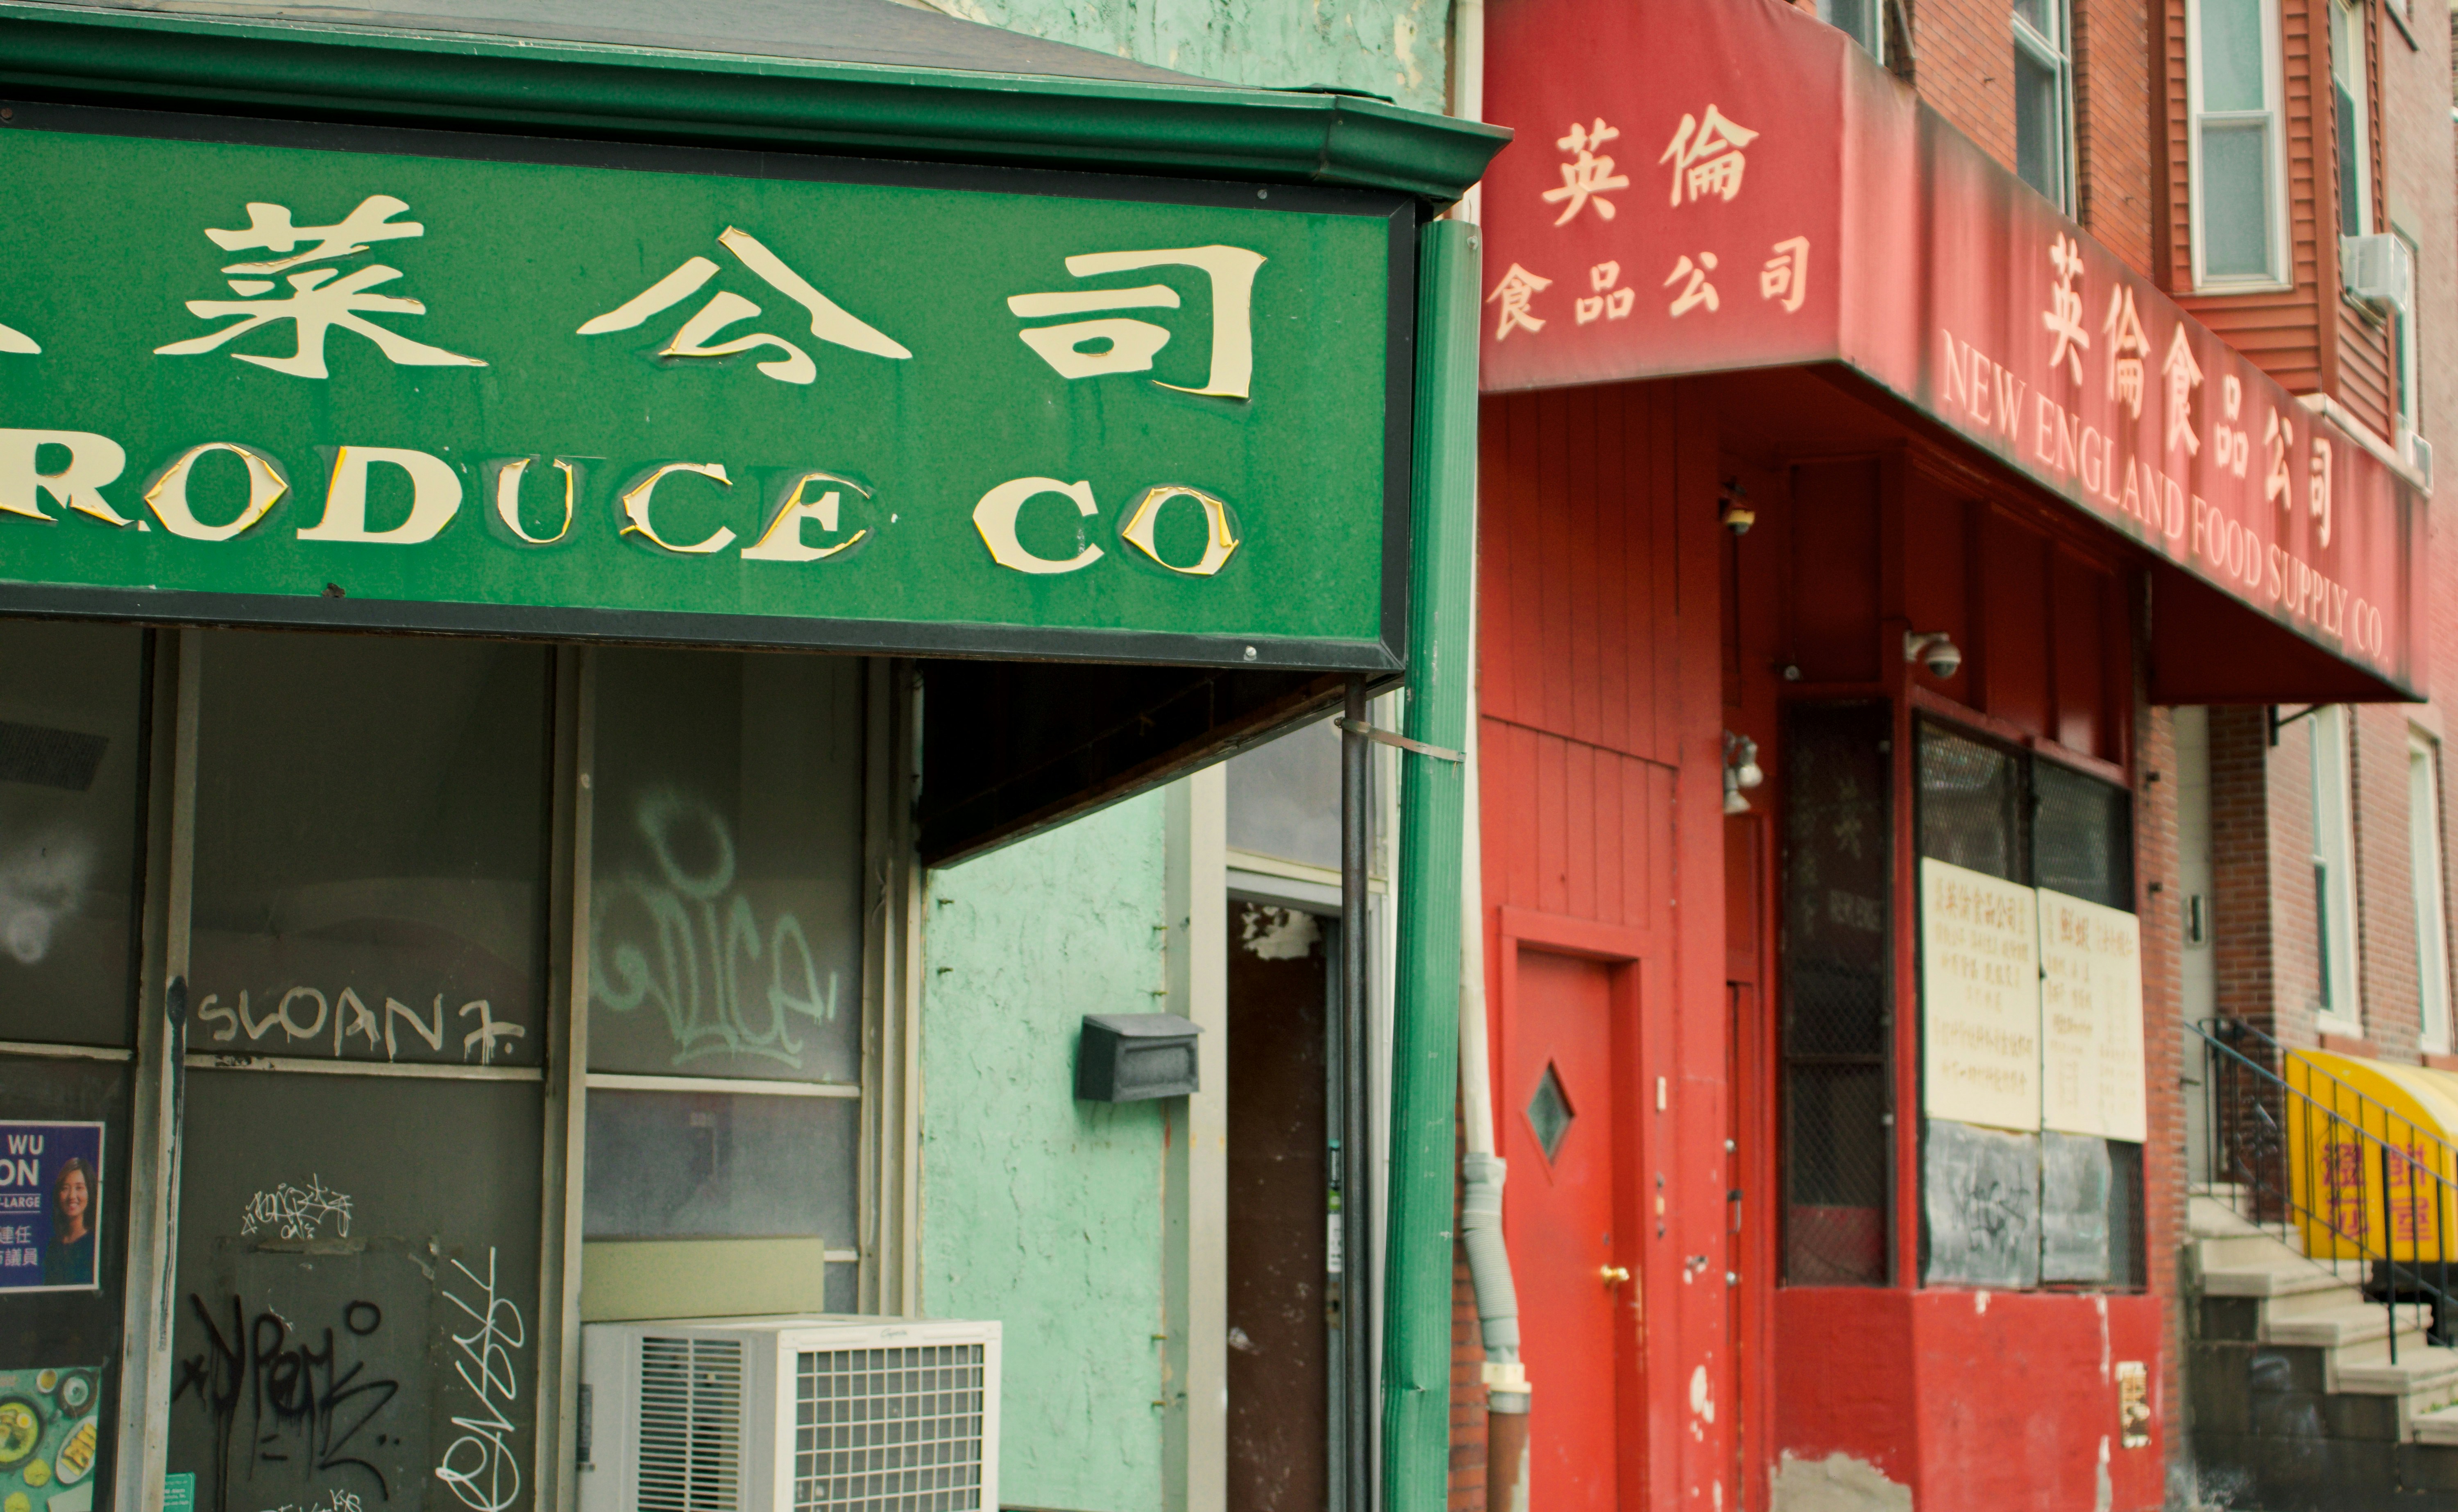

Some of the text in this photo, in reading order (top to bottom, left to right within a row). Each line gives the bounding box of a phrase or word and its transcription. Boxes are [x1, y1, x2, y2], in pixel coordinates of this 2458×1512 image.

[1542, 103, 1759, 226] 英倫
[0, 195, 1268, 399] 菜公司
[1486, 235, 1810, 341] 食品公司
[2043, 231, 2332, 549] 英倫食品公司
[972, 476, 1240, 577] CO
[1943, 328, 2027, 441] NEW
[2035, 391, 2184, 539] ENGLAND
[2192, 493, 2262, 589] FOOD
[2268, 543, 2348, 638] SUPPLY
[7, 1134, 44, 1155] WU
[0, 1247, 39, 1266] 議員
